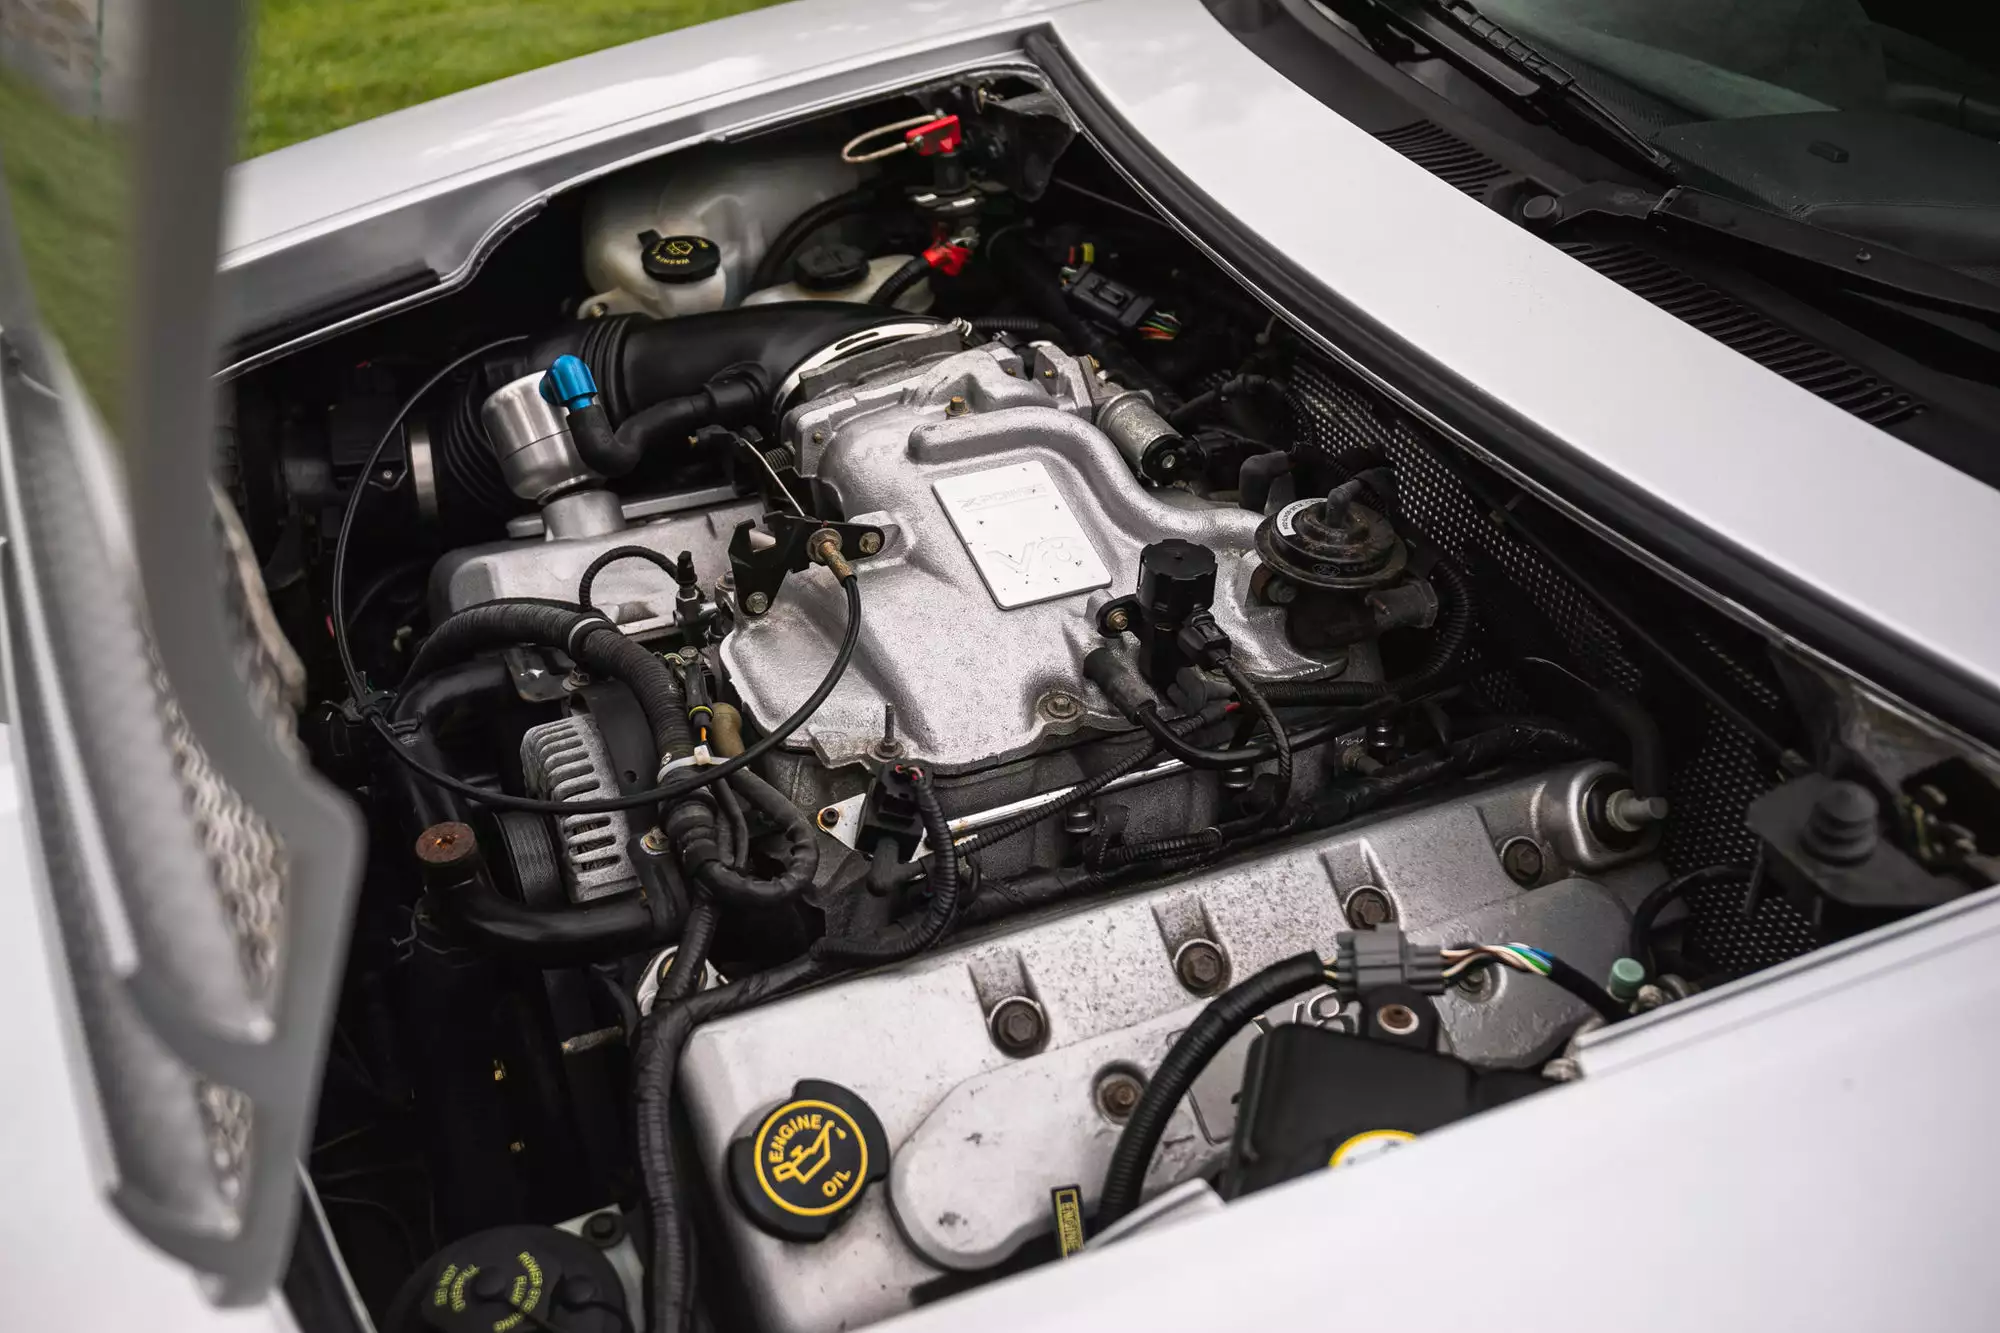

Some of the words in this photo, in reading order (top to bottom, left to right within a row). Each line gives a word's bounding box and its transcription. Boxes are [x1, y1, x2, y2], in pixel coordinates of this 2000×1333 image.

[768, 1113, 822, 1163] ENGINE
[822, 1169, 851, 1198] OIL
[518, 1251, 543, 1288] POWER
